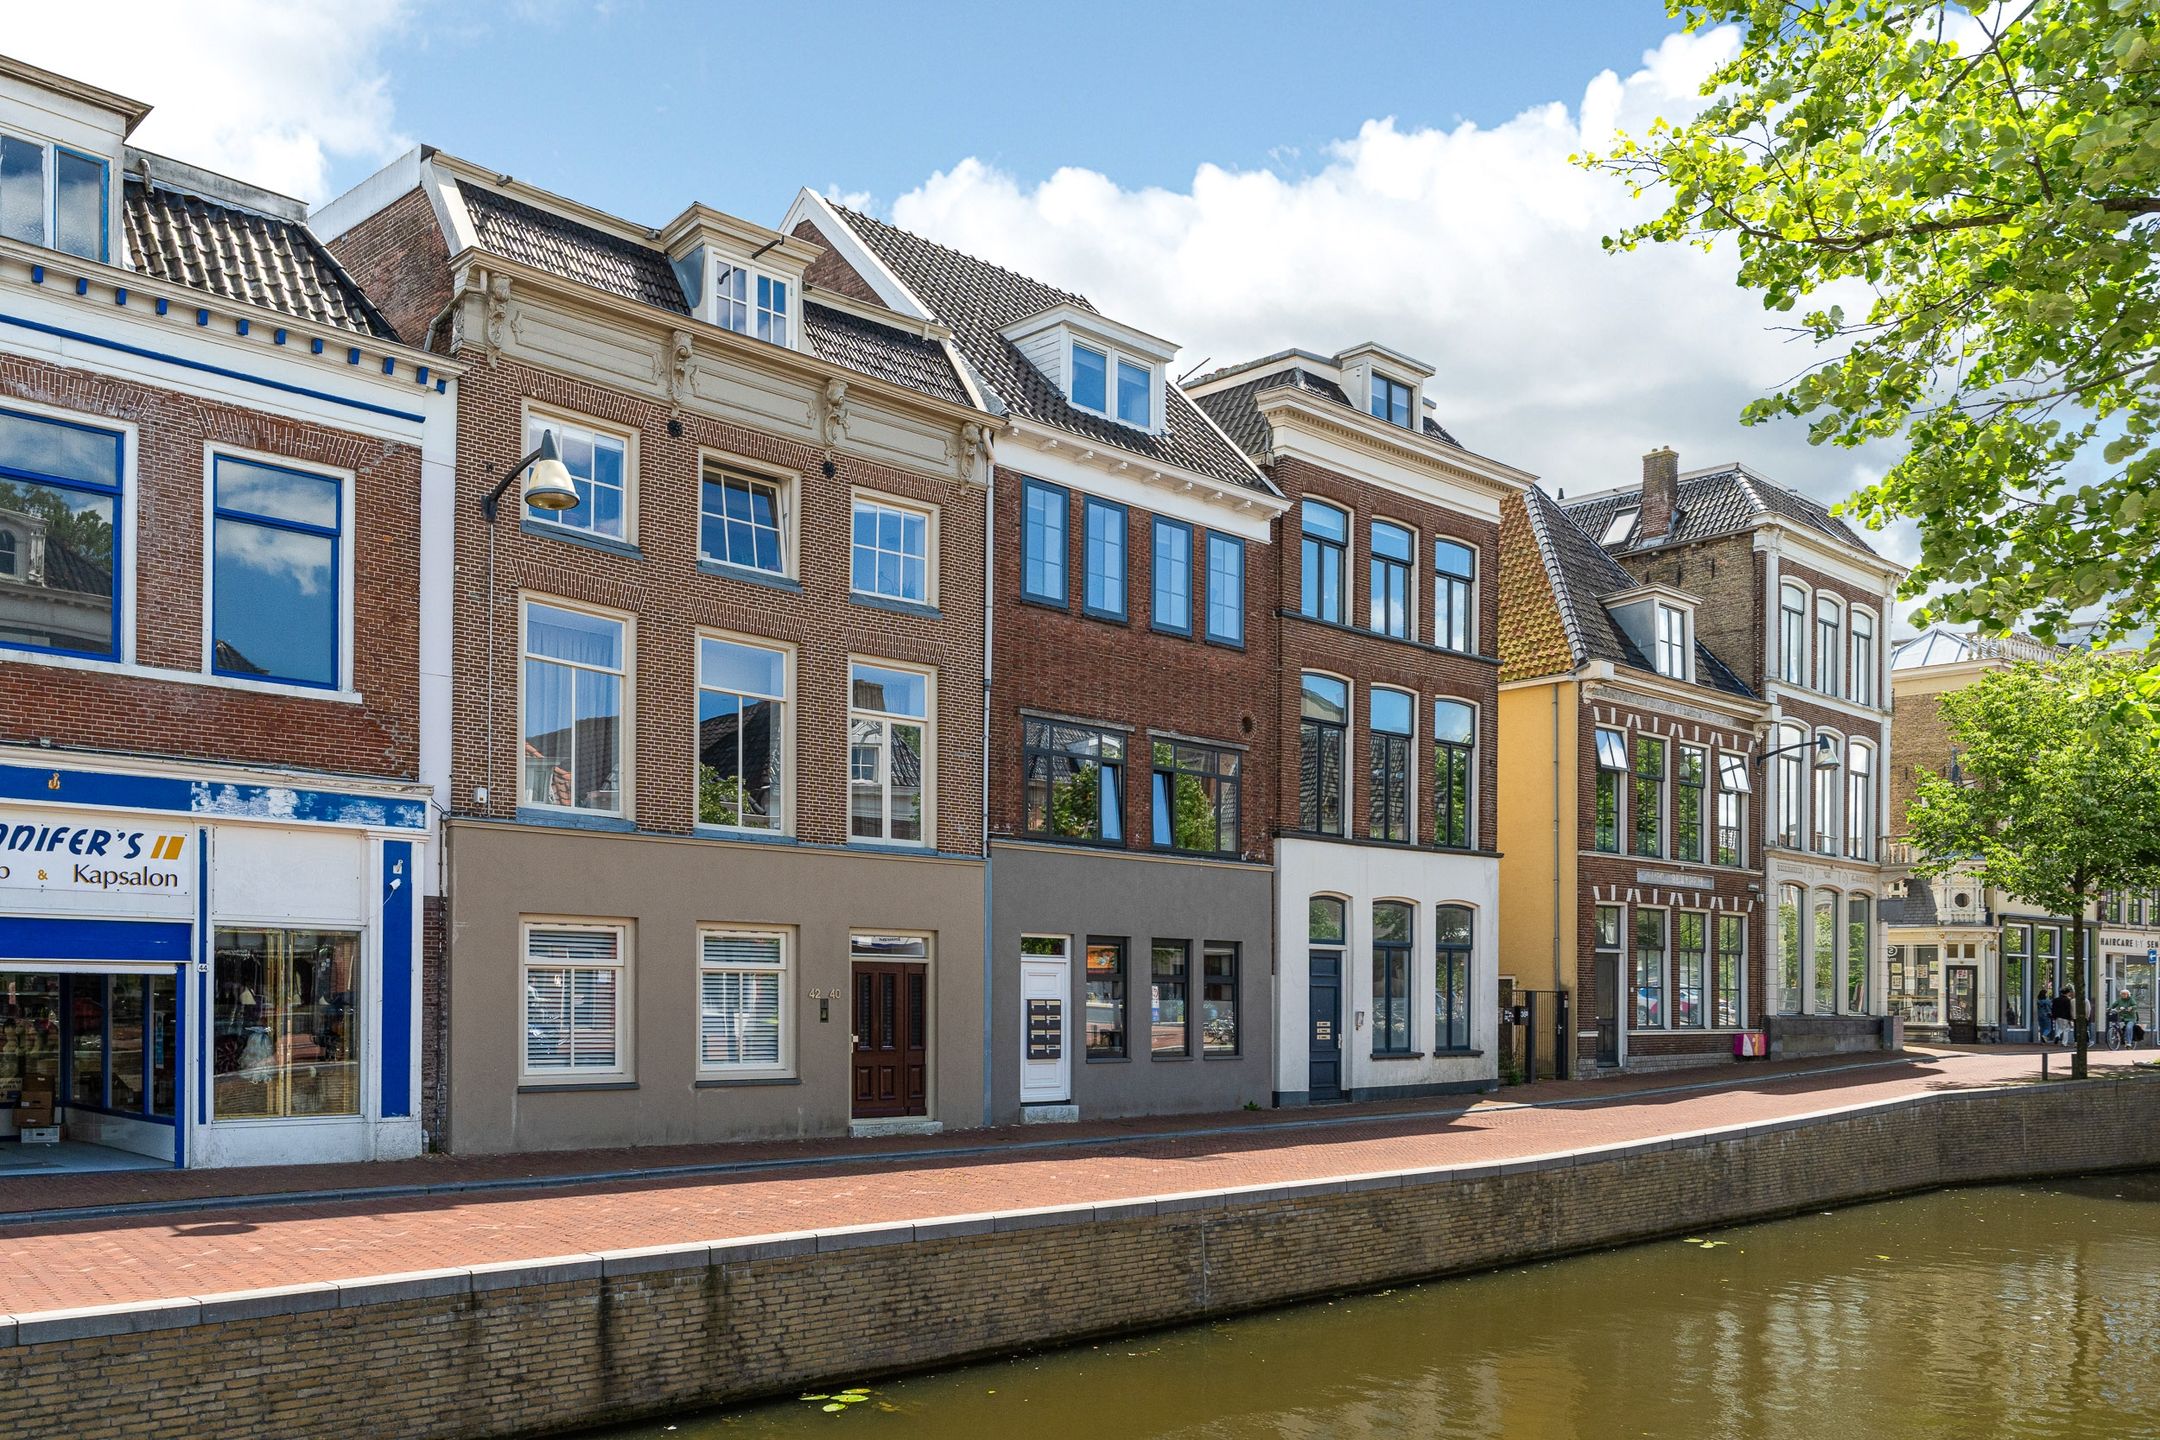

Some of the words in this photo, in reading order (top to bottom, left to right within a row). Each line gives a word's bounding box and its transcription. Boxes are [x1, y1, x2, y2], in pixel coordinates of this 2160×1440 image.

[37, 869, 49, 881] &
[73, 863, 178, 889] Kapsalon
[2100, 937, 2134, 948] HAIRCARE
[809, 988, 821, 999] 42
[829, 988, 842, 999] 40
